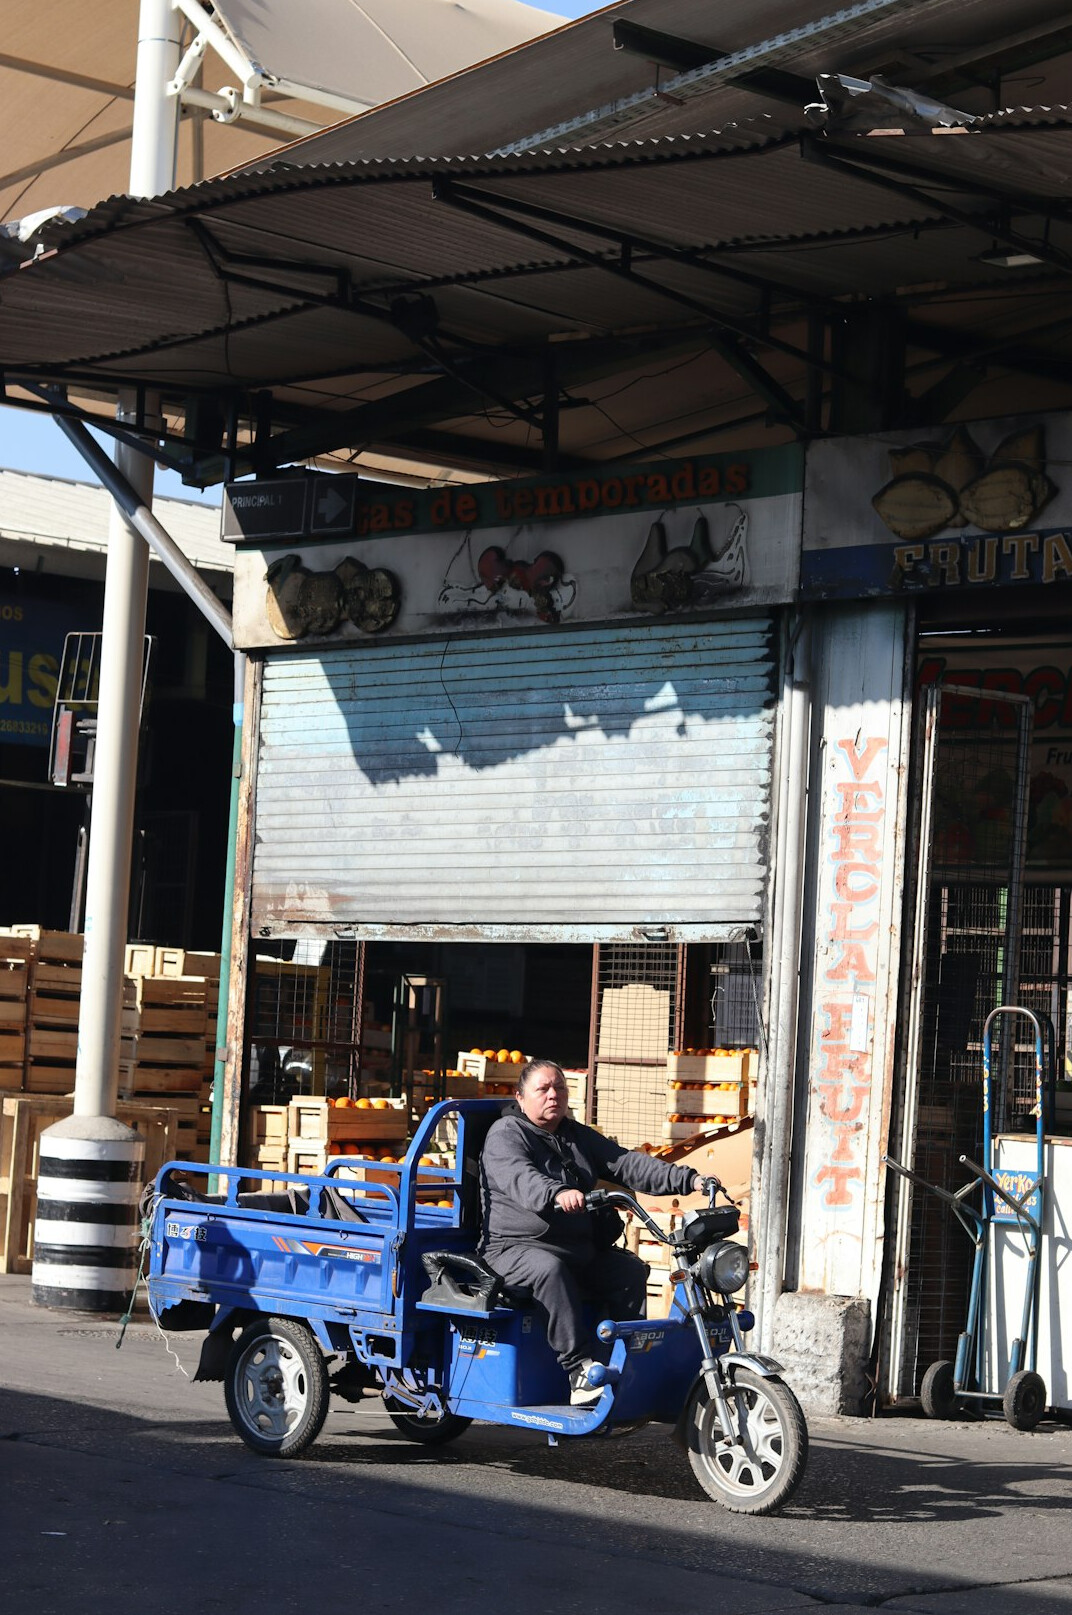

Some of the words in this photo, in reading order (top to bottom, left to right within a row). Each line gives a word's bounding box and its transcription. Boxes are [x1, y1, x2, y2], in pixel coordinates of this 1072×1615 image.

[430, 488, 478, 525] de
[495, 462, 750, 520] temporadas
[231, 494, 275, 508] PRINCIPAL
[346, 1252, 363, 1261] HIGH
